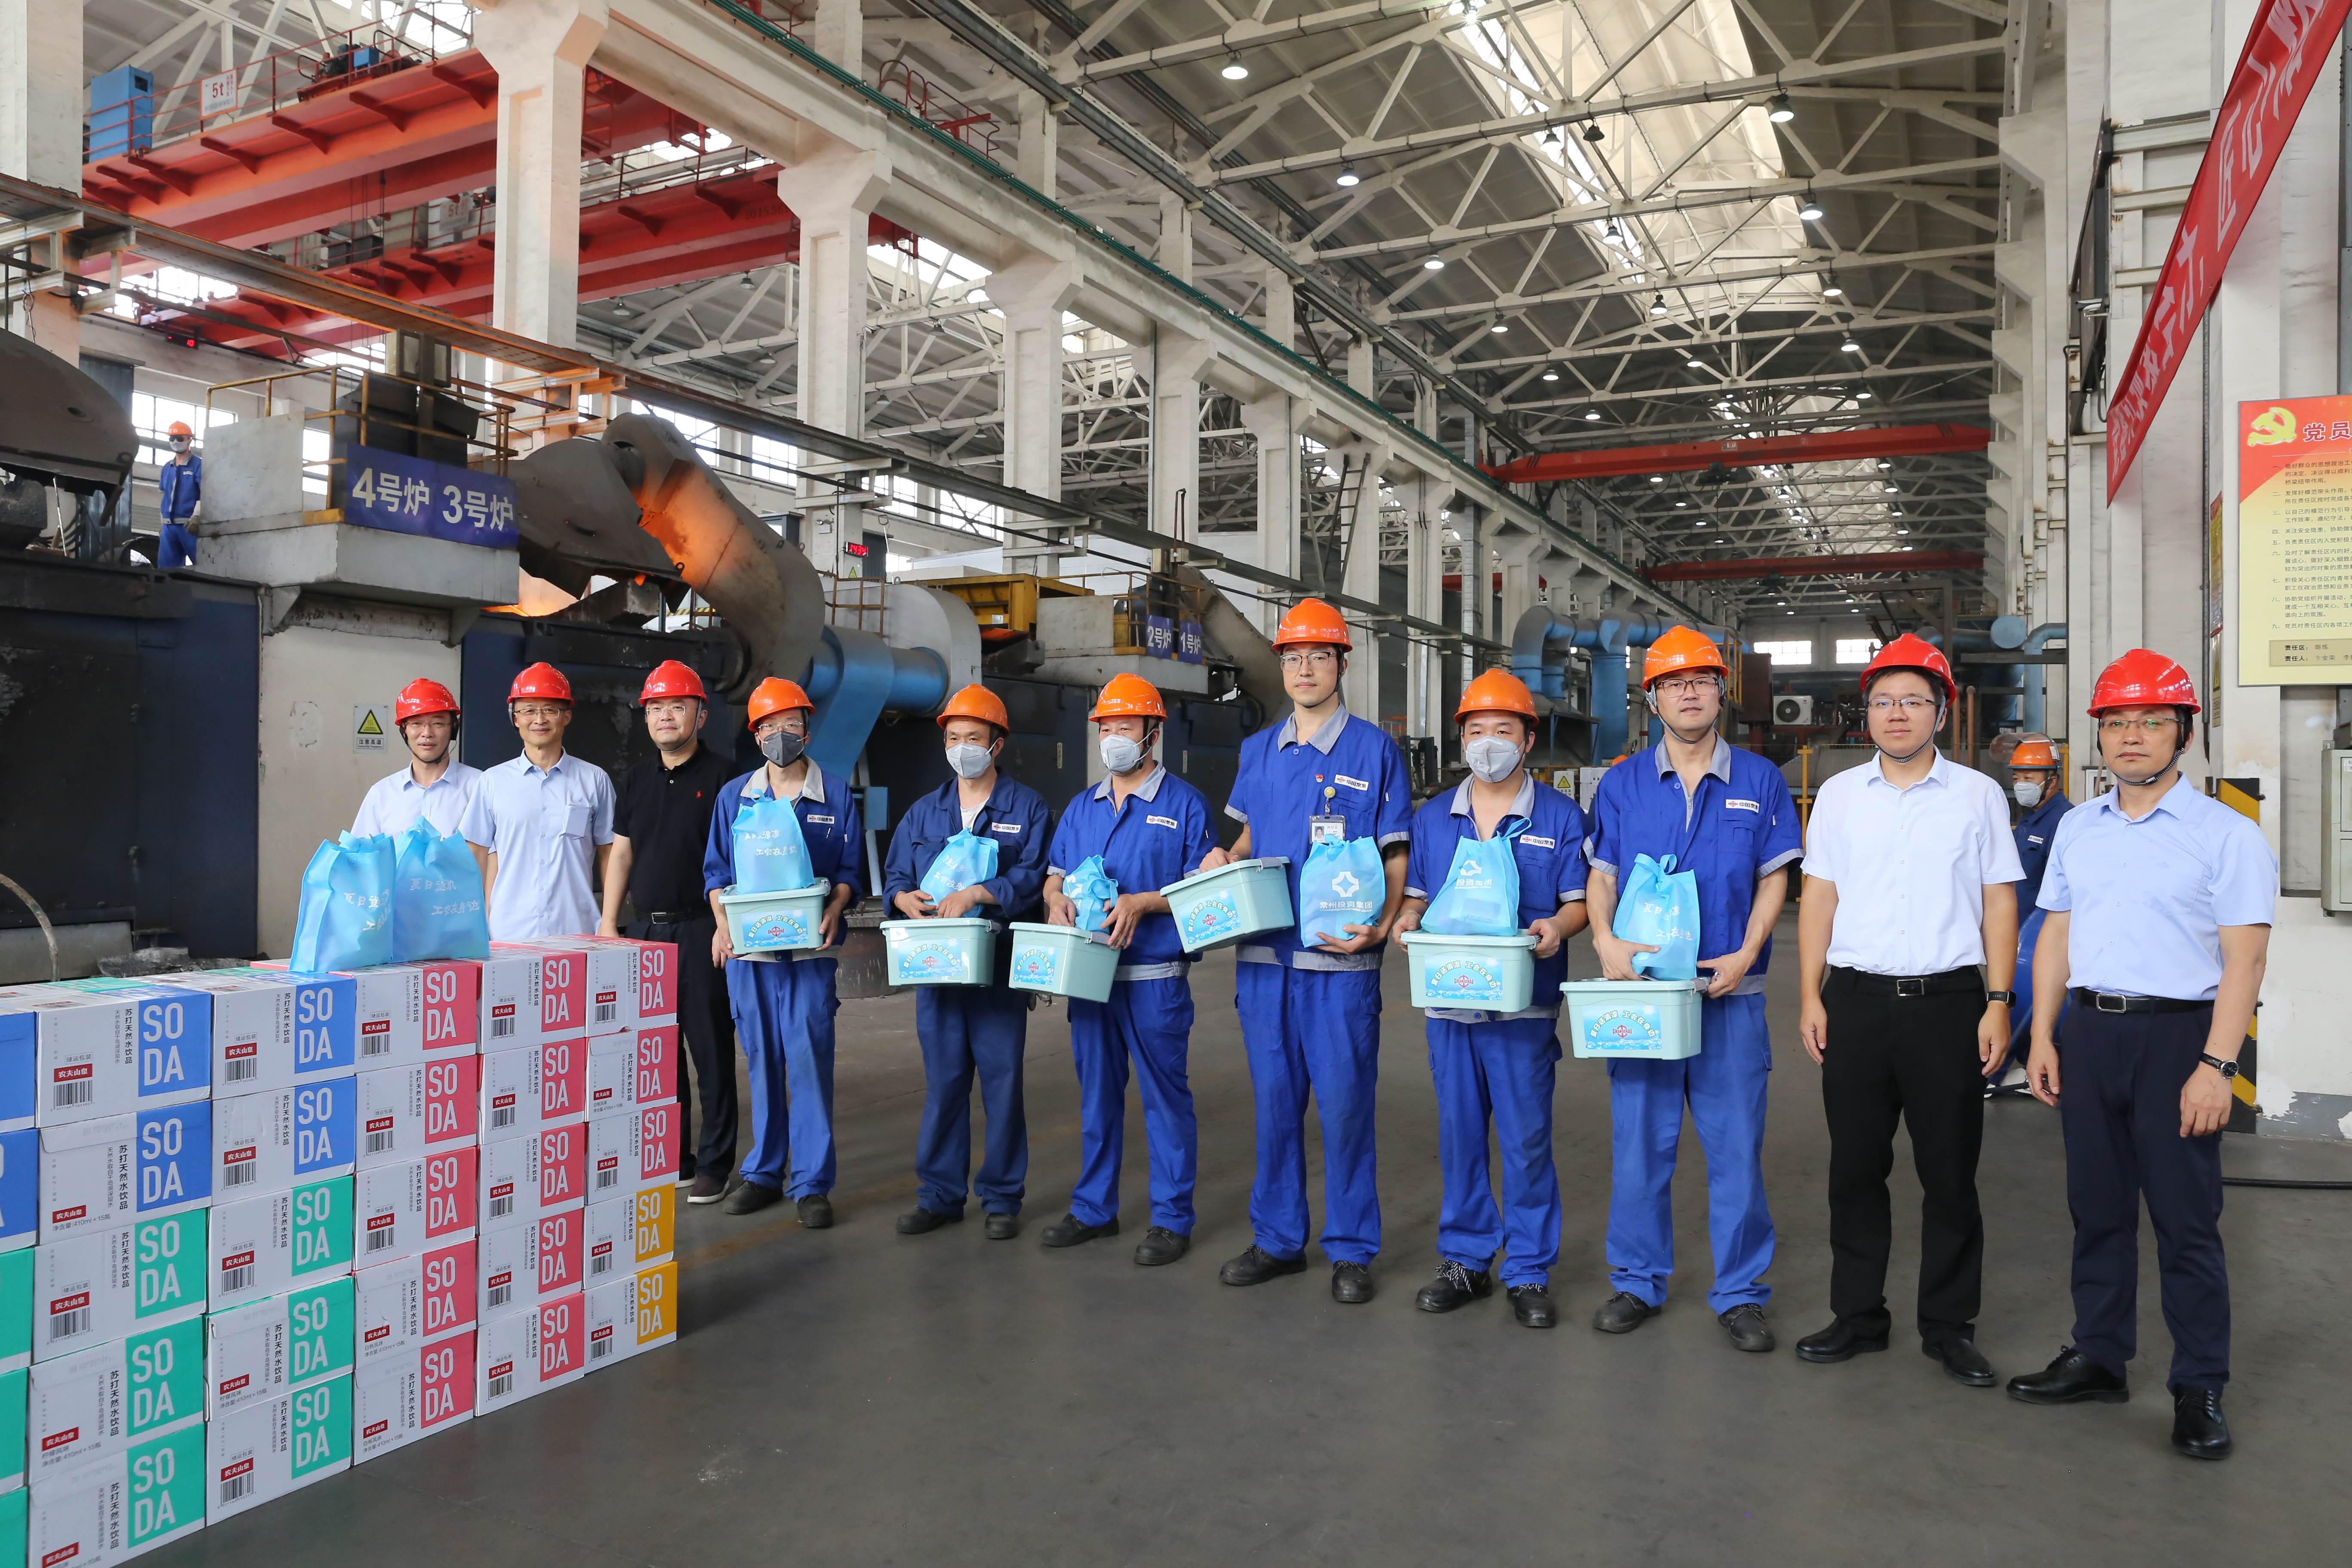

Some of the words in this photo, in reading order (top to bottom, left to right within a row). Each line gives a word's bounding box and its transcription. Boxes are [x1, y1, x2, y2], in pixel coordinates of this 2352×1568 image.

[212, 82, 224, 98] 5t
[2303, 422, 2352, 442] 党员
[352, 468, 430, 516] 4号炉
[442, 485, 514, 531] 3号炉
[1148, 625, 1171, 649] 2号炉
[1181, 632, 1201, 655] 1号炉
[1188, 903, 1204, 932] 夏日送清凉
[1206, 900, 1234, 918] 工会在身边
[1320, 900, 1372, 909] 常州投资集团
[748, 915, 772, 938] 夏日送清凉
[776, 915, 803, 934] 工会在身边
[643, 949, 664, 978] SO
[903, 944, 928, 968] 夏日送清凉
[931, 944, 957, 966] 工会在身边
[426, 971, 456, 1004] SO
[545, 959, 570, 989] SO
[1430, 960, 1462, 986] 夏日送清凉
[1465, 961, 1498, 989] 工会在身边
[299, 988, 333, 1023] SO
[545, 993, 569, 1023] DA
[598, 993, 614, 1001] 农夫山泉
[642, 981, 664, 1010] DA
[125, 1008, 133, 1064] 苏打天然水饮品
[144, 1003, 183, 1042] SO
[427, 1008, 456, 1041] DA
[1589, 1010, 1619, 1038] 夏日送清凉
[1622, 1010, 1656, 1038] 工会在身边
[66, 1054, 92, 1063] 储运包装
[229, 1045, 253, 1056] 农夫山泉
[300, 1027, 333, 1063] DA
[545, 1045, 569, 1076] SO
[640, 1036, 662, 1066] SO
[58, 1068, 88, 1079] 农夫山泉
[144, 1045, 184, 1085] DA
[429, 1063, 457, 1097] SO
[545, 1079, 569, 1111] DA
[640, 1069, 661, 1098] DA
[298, 1088, 332, 1124] SO
[429, 1100, 458, 1134] DA
[142, 1118, 182, 1160] SO
[369, 1120, 390, 1129] 农夫山泉
[644, 1110, 666, 1139] SO
[227, 1149, 253, 1161] 农夫山泉
[299, 1127, 333, 1164] DA
[544, 1132, 569, 1164] SO
[644, 1142, 666, 1172] DA
[119, 1145, 128, 1210] 苏打天然水饮品
[143, 1161, 183, 1204] DA
[430, 1157, 457, 1191] SO
[544, 1166, 568, 1198] DA
[56, 1207, 83, 1220] 农夫山泉
[297, 1188, 330, 1225] SO
[370, 1217, 391, 1228] 农夫山泉
[430, 1194, 457, 1229] DA
[639, 1192, 660, 1222] SO
[139, 1220, 180, 1264] SO
[297, 1227, 330, 1265] DA
[542, 1218, 567, 1250] SO
[639, 1224, 660, 1254] DA
[122, 1232, 130, 1288] 苏打天然水饮品
[226, 1255, 251, 1267] 农夫山泉
[427, 1257, 456, 1292] SO
[542, 1252, 566, 1285] DA
[141, 1264, 181, 1307] DA
[640, 1274, 663, 1305] SO
[55, 1296, 85, 1311] 农夫山泉
[293, 1297, 328, 1336] SO
[427, 1292, 457, 1329] DA
[368, 1329, 387, 1339] 农夫山泉
[543, 1305, 568, 1338] SO
[640, 1305, 662, 1336] DA
[132, 1338, 173, 1383] SO
[274, 1324, 282, 1384] 苏打天然水饮品
[294, 1335, 329, 1377] DA
[425, 1348, 453, 1384] SO
[544, 1338, 569, 1372] DA
[224, 1378, 246, 1390] 农夫山泉
[110, 1370, 119, 1436] 苏打天然水饮品
[134, 1381, 175, 1428] DA
[296, 1387, 330, 1427] SO
[425, 1382, 455, 1422] DA
[366, 1423, 385, 1436] 农夫山泉
[297, 1426, 330, 1469] DA
[133, 1448, 175, 1493] SO
[225, 1462, 249, 1477] 农夫山泉
[110, 1482, 119, 1549] 苏打天然水饮品
[135, 1489, 176, 1538] DA
